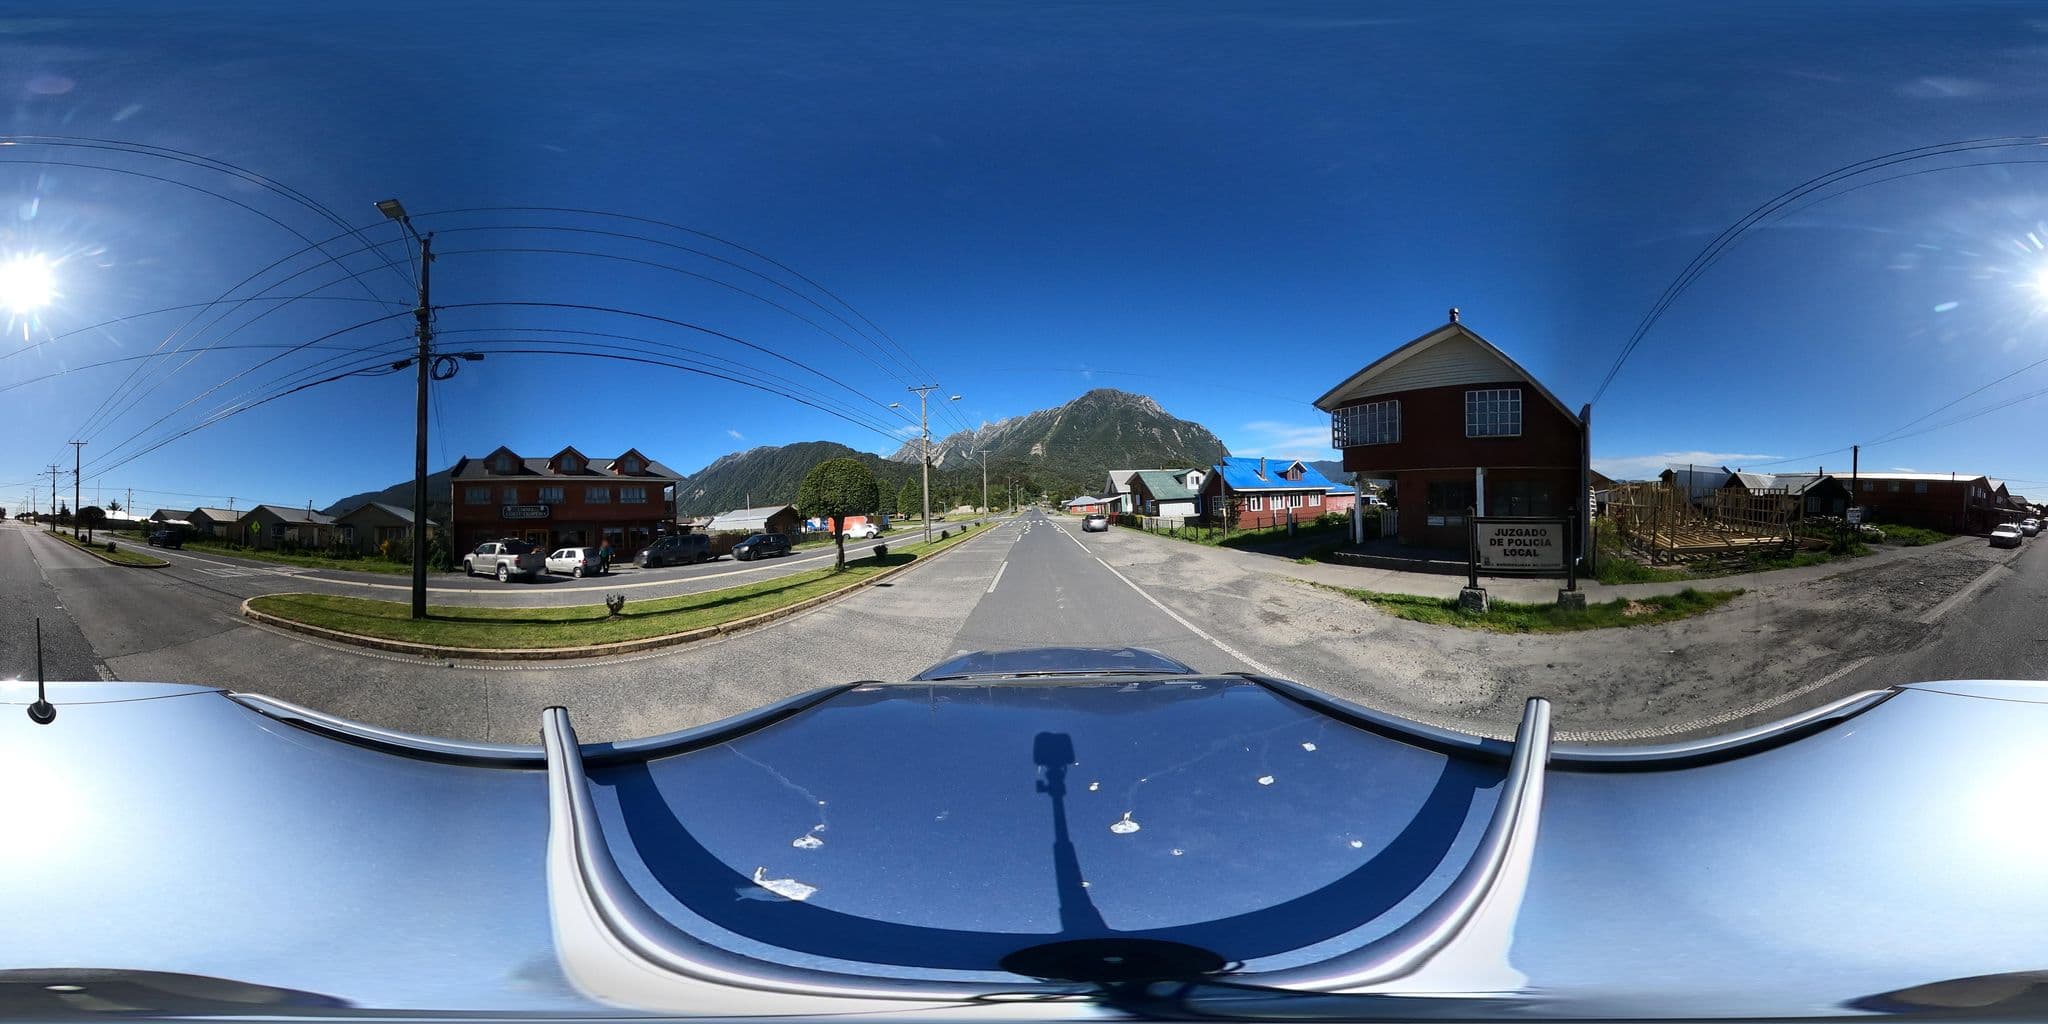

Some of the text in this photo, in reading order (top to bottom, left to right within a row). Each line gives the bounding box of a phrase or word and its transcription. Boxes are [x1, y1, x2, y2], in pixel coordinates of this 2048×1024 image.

[1494, 529, 1547, 537] JUZGADO
[1489, 538, 1552, 546] DE POLICIA
[1503, 548, 1539, 557] LOCAL
